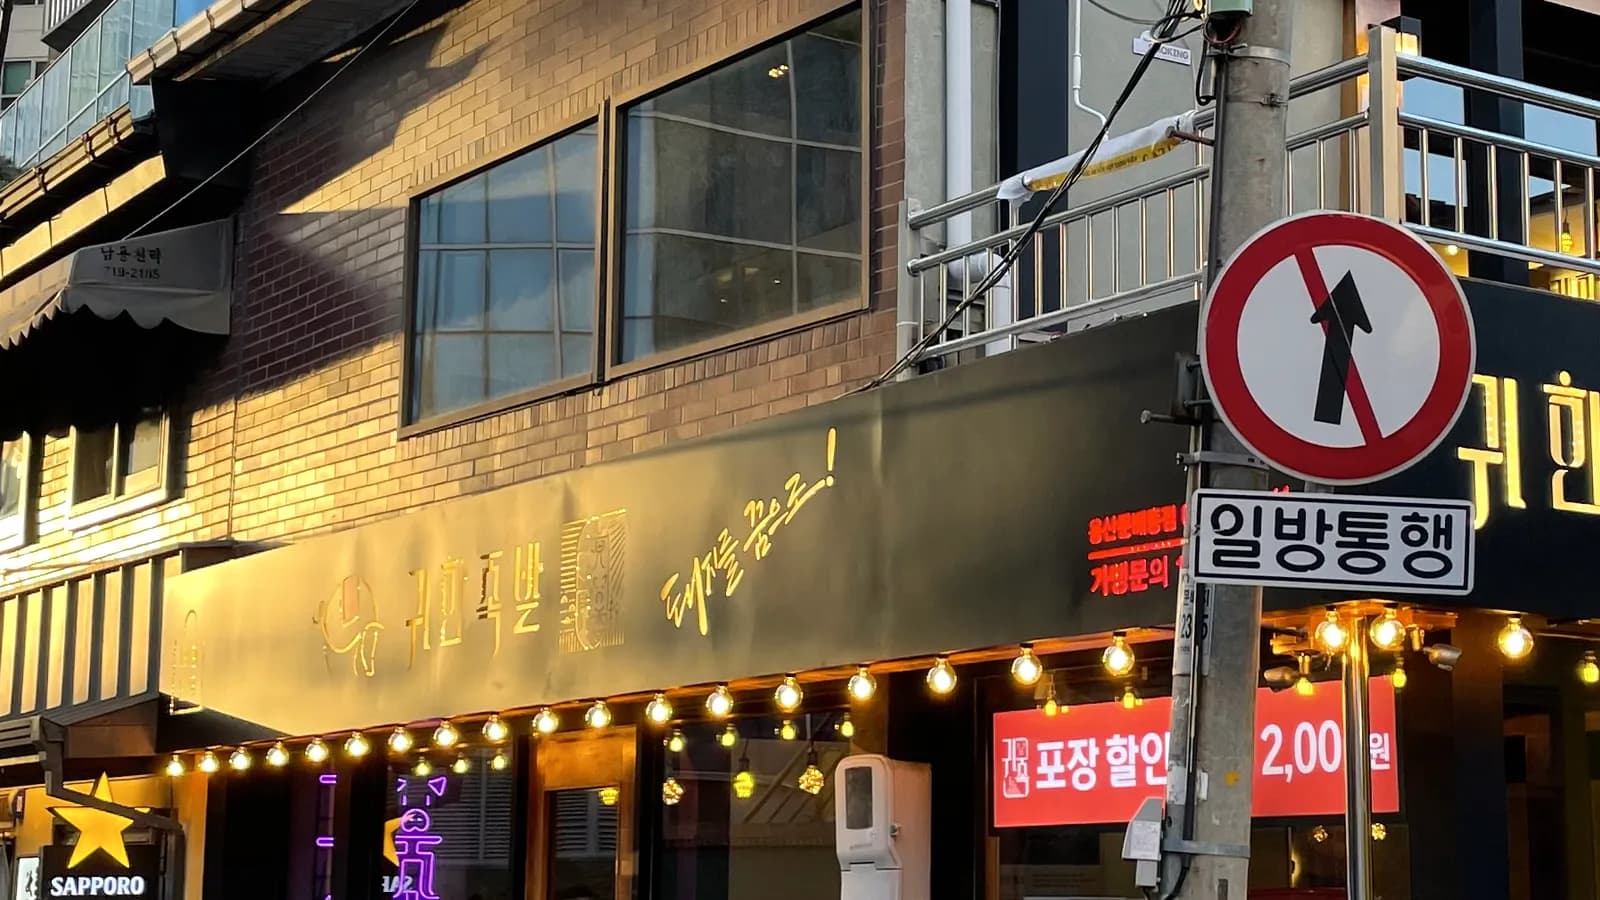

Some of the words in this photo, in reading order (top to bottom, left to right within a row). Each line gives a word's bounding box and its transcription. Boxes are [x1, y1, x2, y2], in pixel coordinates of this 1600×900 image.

[1210, 503, 1454, 579] 일방통행
[1036, 737, 1100, 792] 포장
[1105, 731, 1170, 788] 할인
[50, 875, 145, 897] SAPPORO
